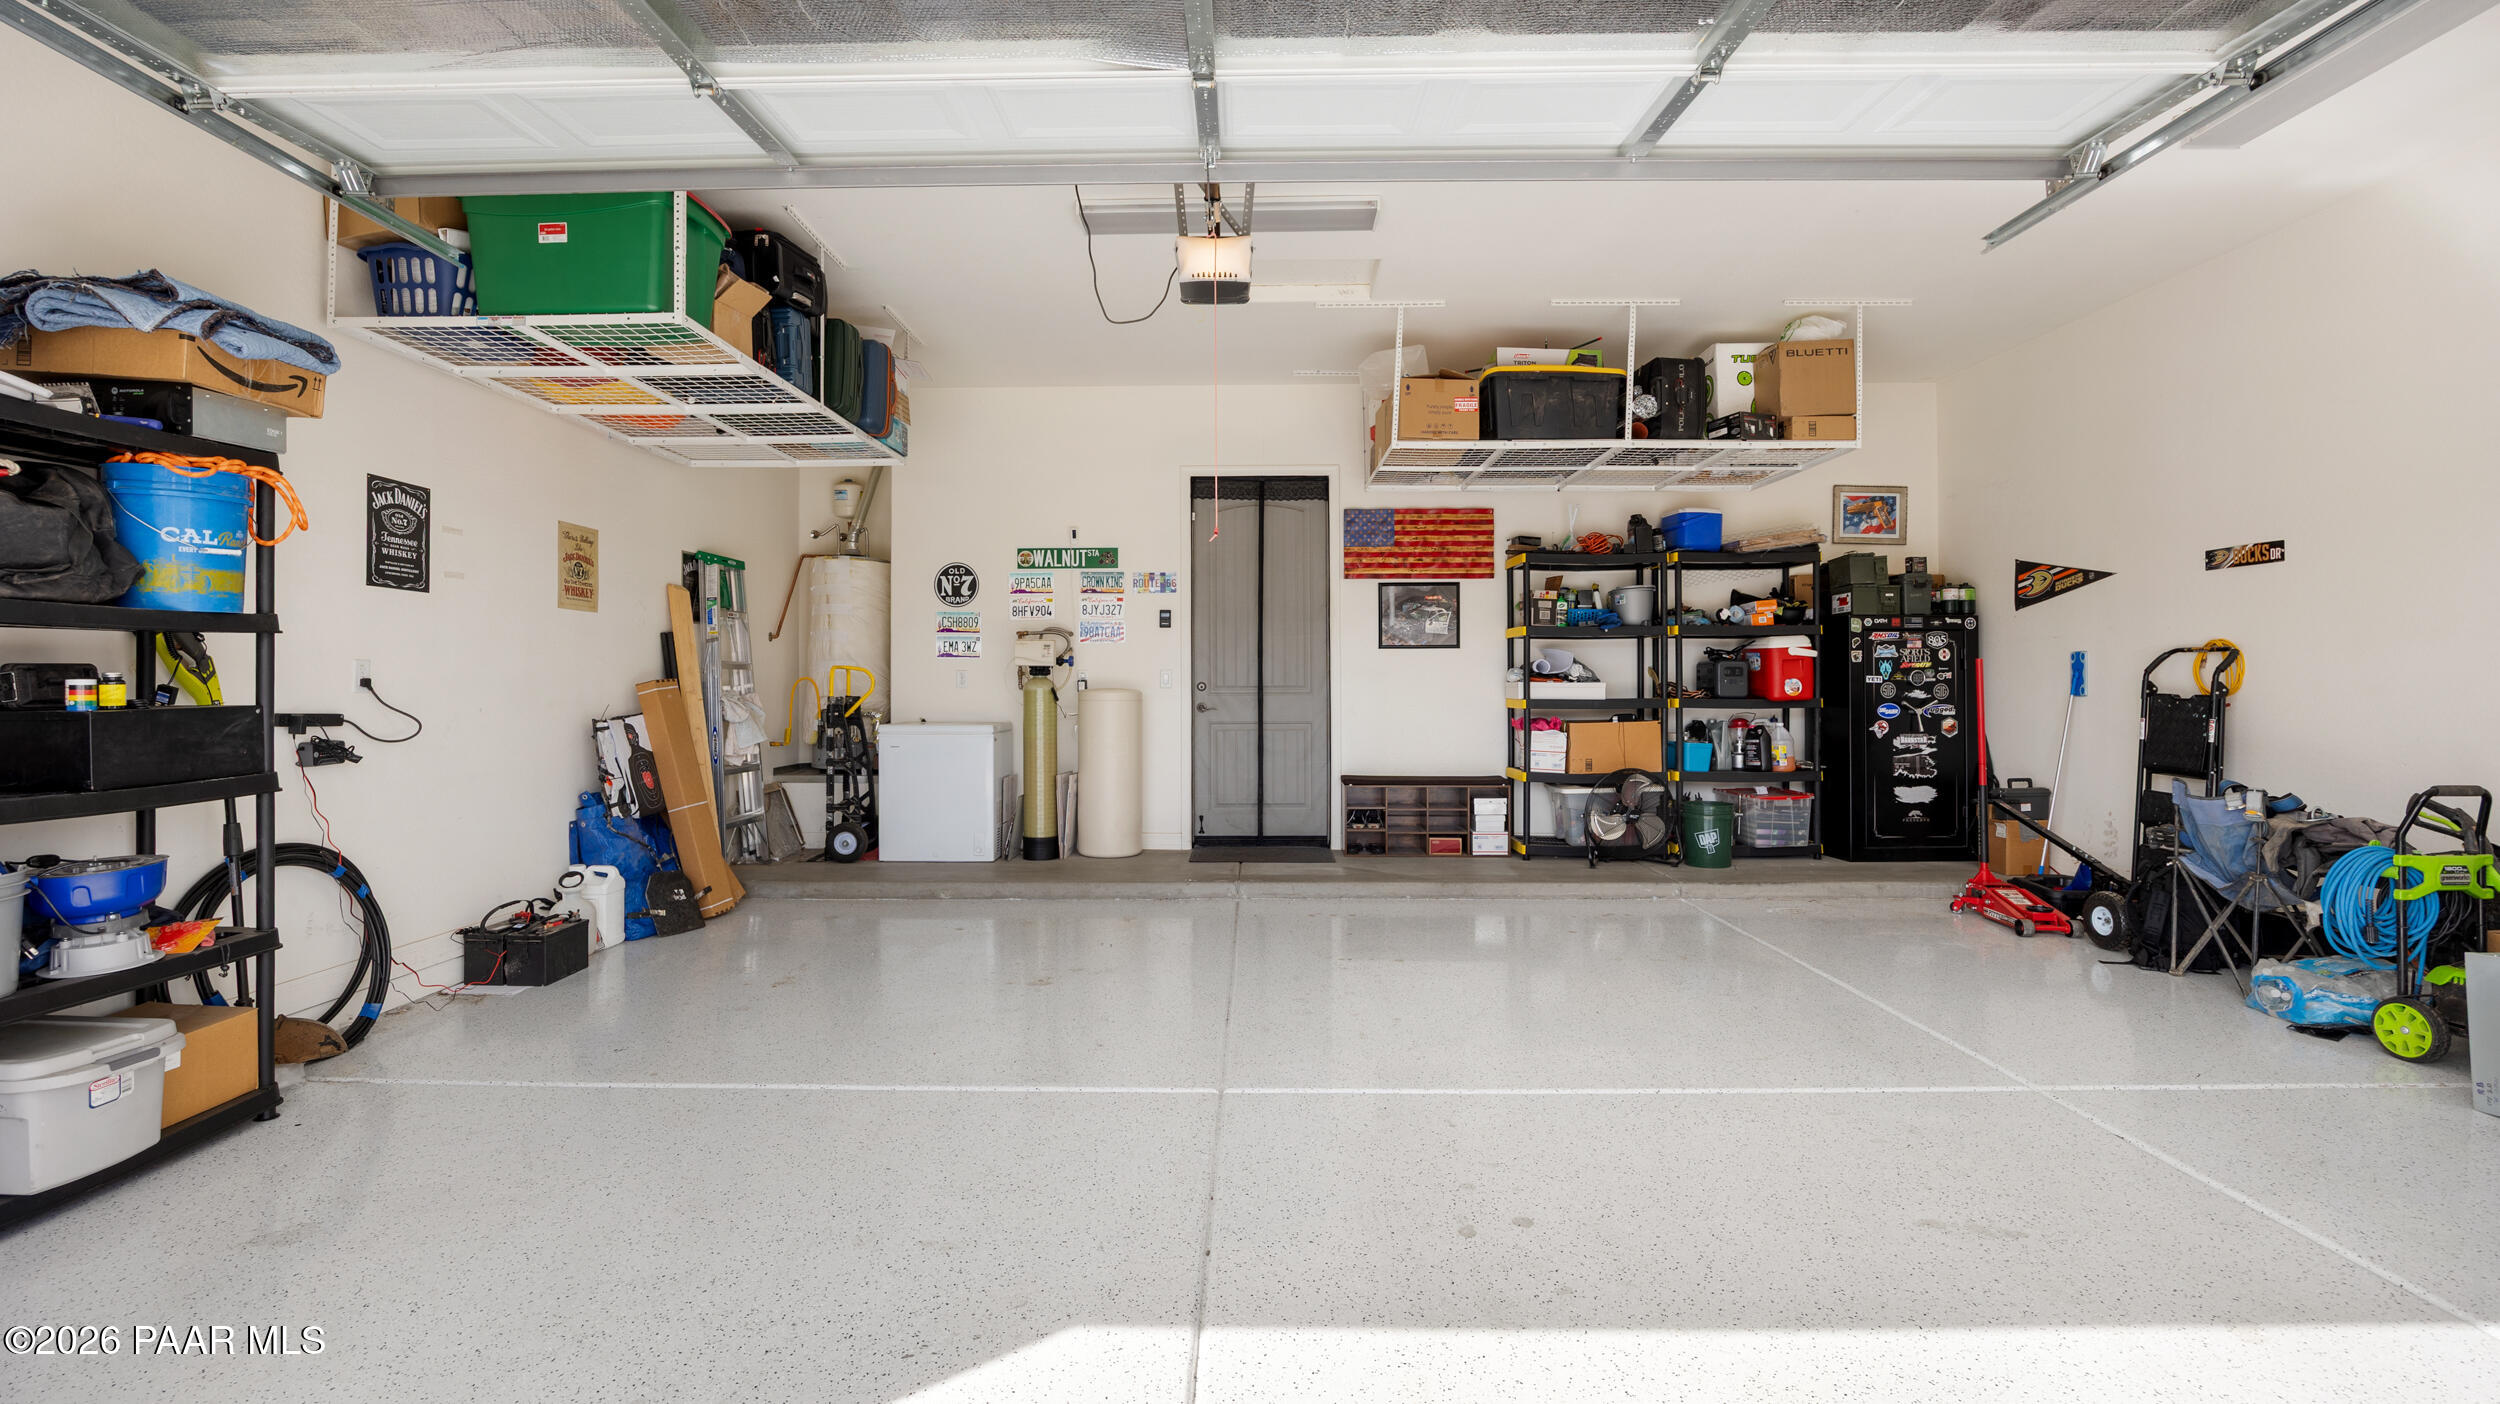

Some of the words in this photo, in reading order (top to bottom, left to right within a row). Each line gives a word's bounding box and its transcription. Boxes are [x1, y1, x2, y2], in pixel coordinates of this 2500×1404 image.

[1786, 347, 1848, 357] BLUETTI
[371, 490, 394, 510] JACK
[394, 487, 428, 519] DANIEL'S
[160, 526, 218, 546] CAL
[380, 531, 419, 548] Tennessee
[381, 547, 418, 560] WHISKEY
[1033, 549, 1088, 568] WALNUT
[1087, 549, 1100, 557] STA
[948, 567, 966, 575] OLD
[1014, 577, 1052, 589] 9PA5CAA
[1081, 575, 1105, 588] CROWN
[1105, 575, 1123, 588] KING
[1132, 578, 1160, 589] ROUTE
[1166, 578, 1177, 588] 66
[564, 584, 594, 600] WHISKEY
[945, 596, 970, 604] BRAND
[1012, 605, 1052, 617] 8HFV904
[1081, 604, 1122, 616] 8JYJ327
[1871, 631, 1899, 640] AMSOIL
[1927, 635, 1947, 645] 805
[943, 640, 959, 653] EMA
[961, 640, 977, 653] 3WZ
[1899, 648, 1931, 656] SPORTS
[1899, 655, 1931, 663] AFIELD
